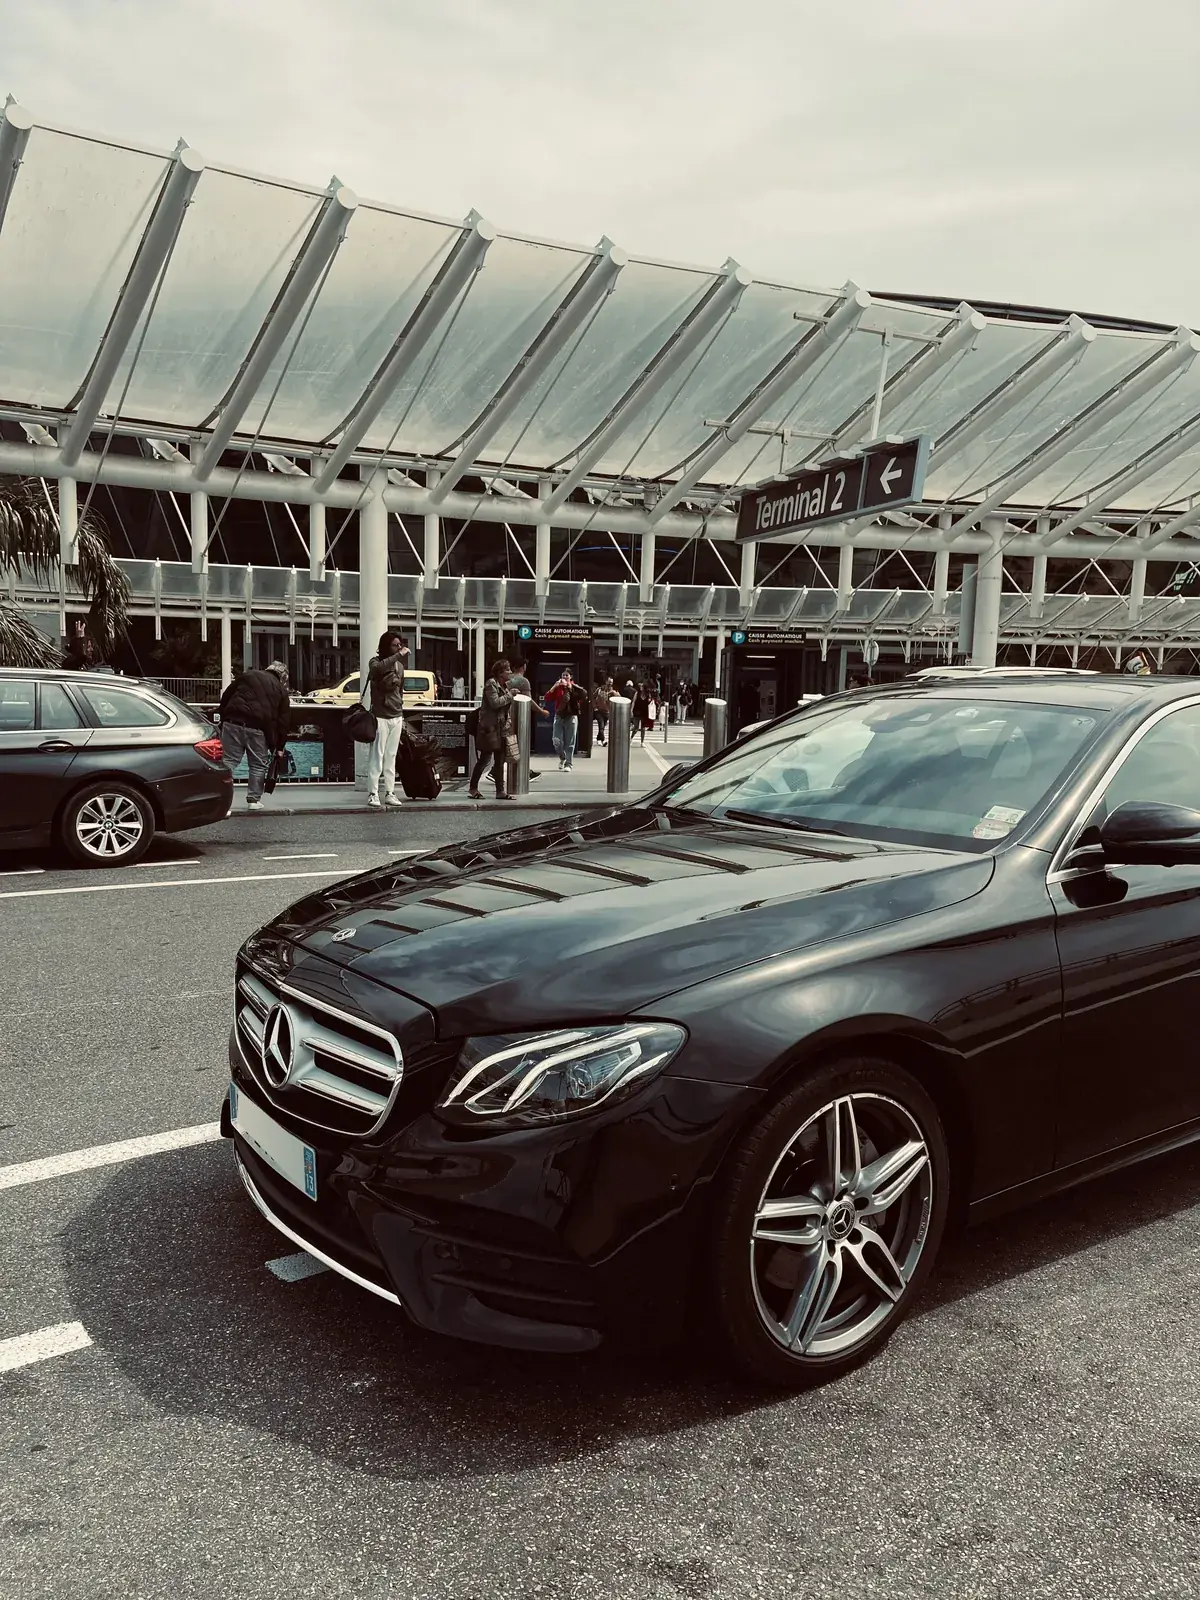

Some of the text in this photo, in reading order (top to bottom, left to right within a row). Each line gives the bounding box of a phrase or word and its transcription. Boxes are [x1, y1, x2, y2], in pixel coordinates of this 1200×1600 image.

[755, 471, 846, 530] Terminal 2
[521, 627, 529, 637] P
[735, 632, 742, 642] P
